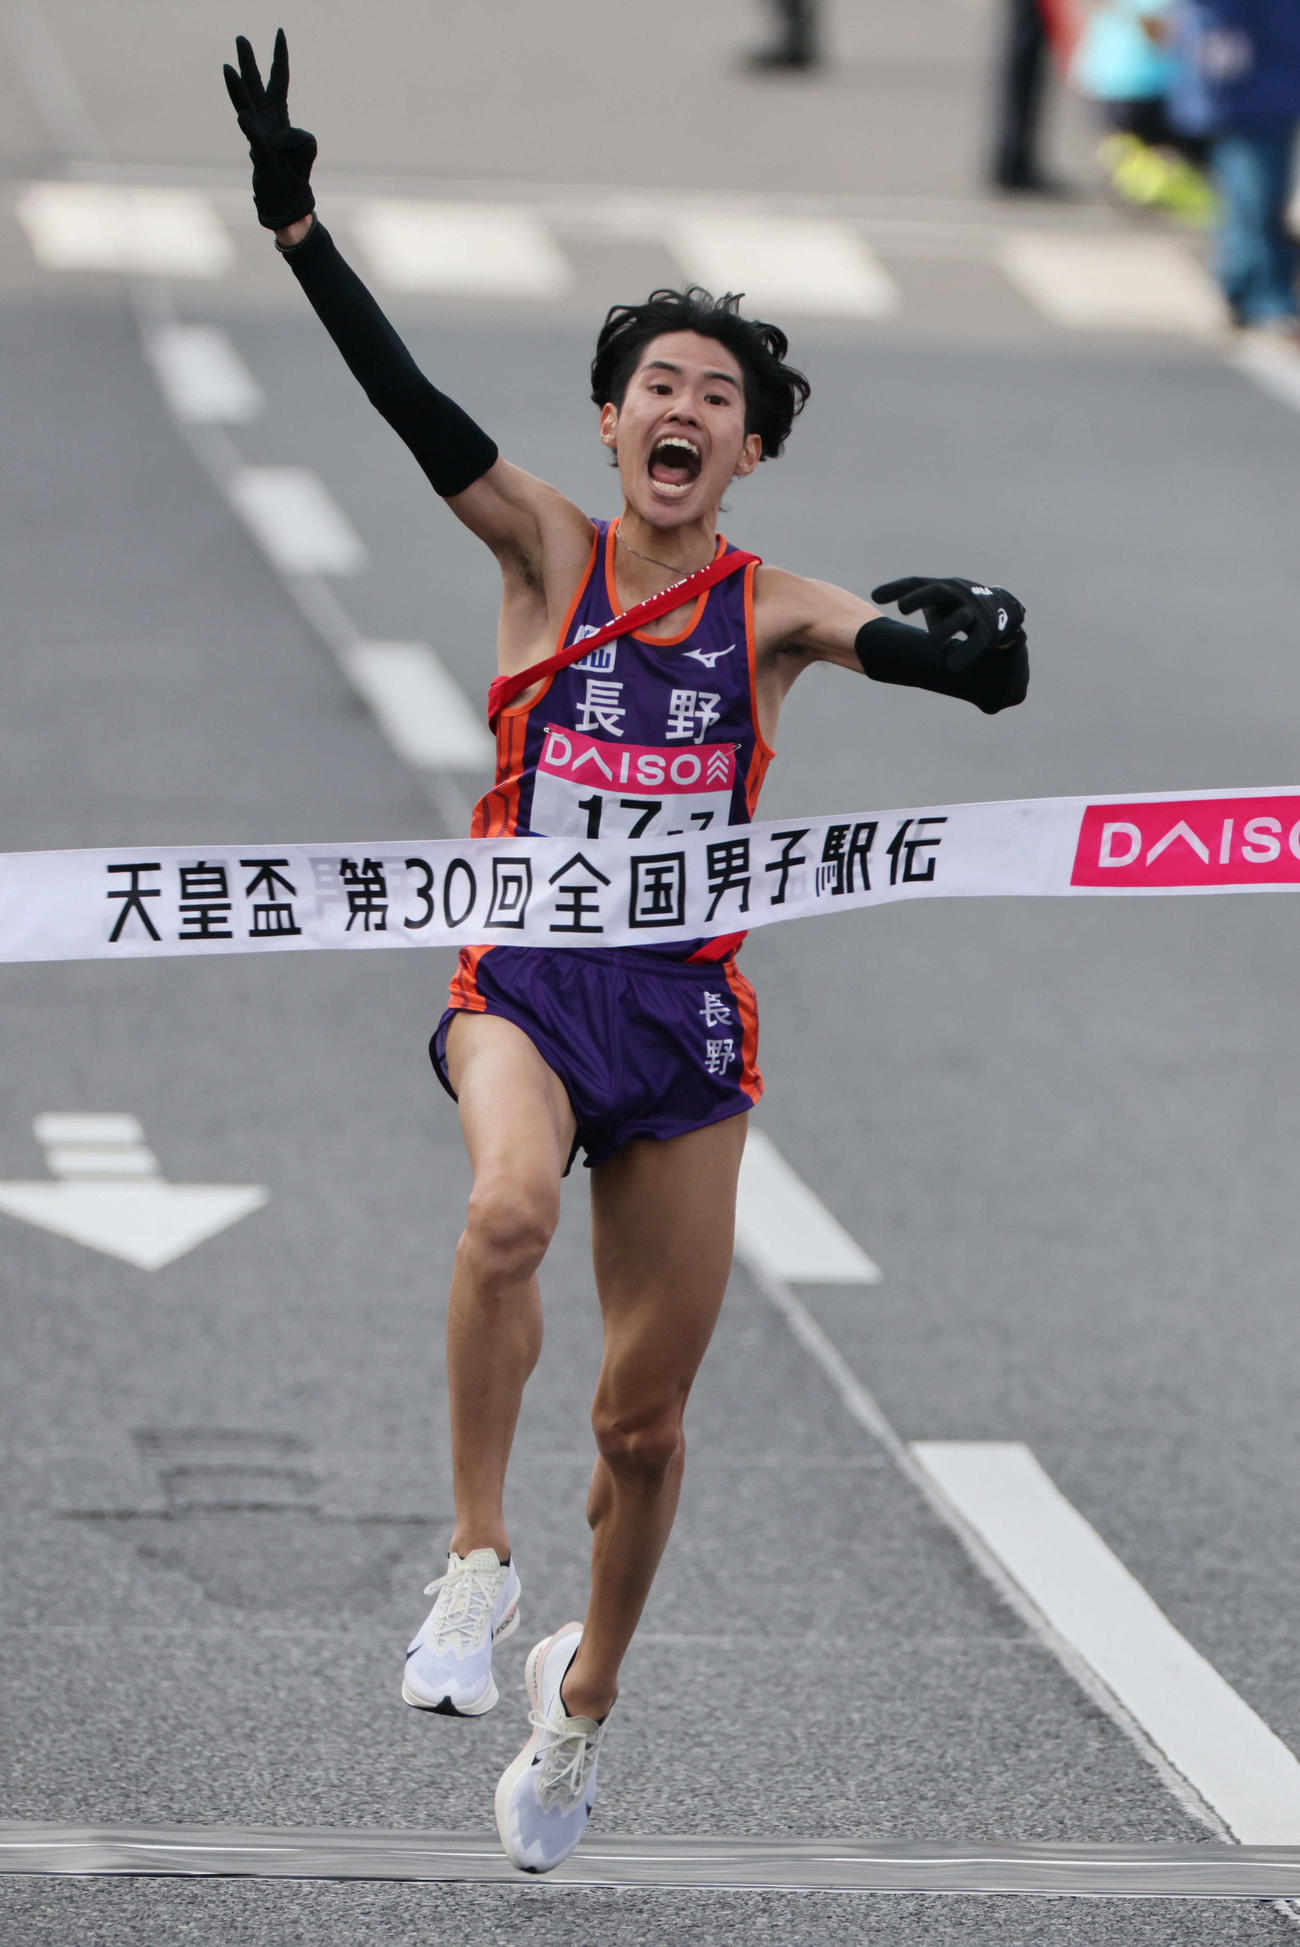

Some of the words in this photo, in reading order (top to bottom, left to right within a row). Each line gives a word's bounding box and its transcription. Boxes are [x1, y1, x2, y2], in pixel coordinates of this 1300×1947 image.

[545, 732, 701, 785] DAISO
[1098, 817, 1300, 868] DAIS
[106, 859, 302, 942] 天皇盃
[699, 991, 735, 1076] 長野
